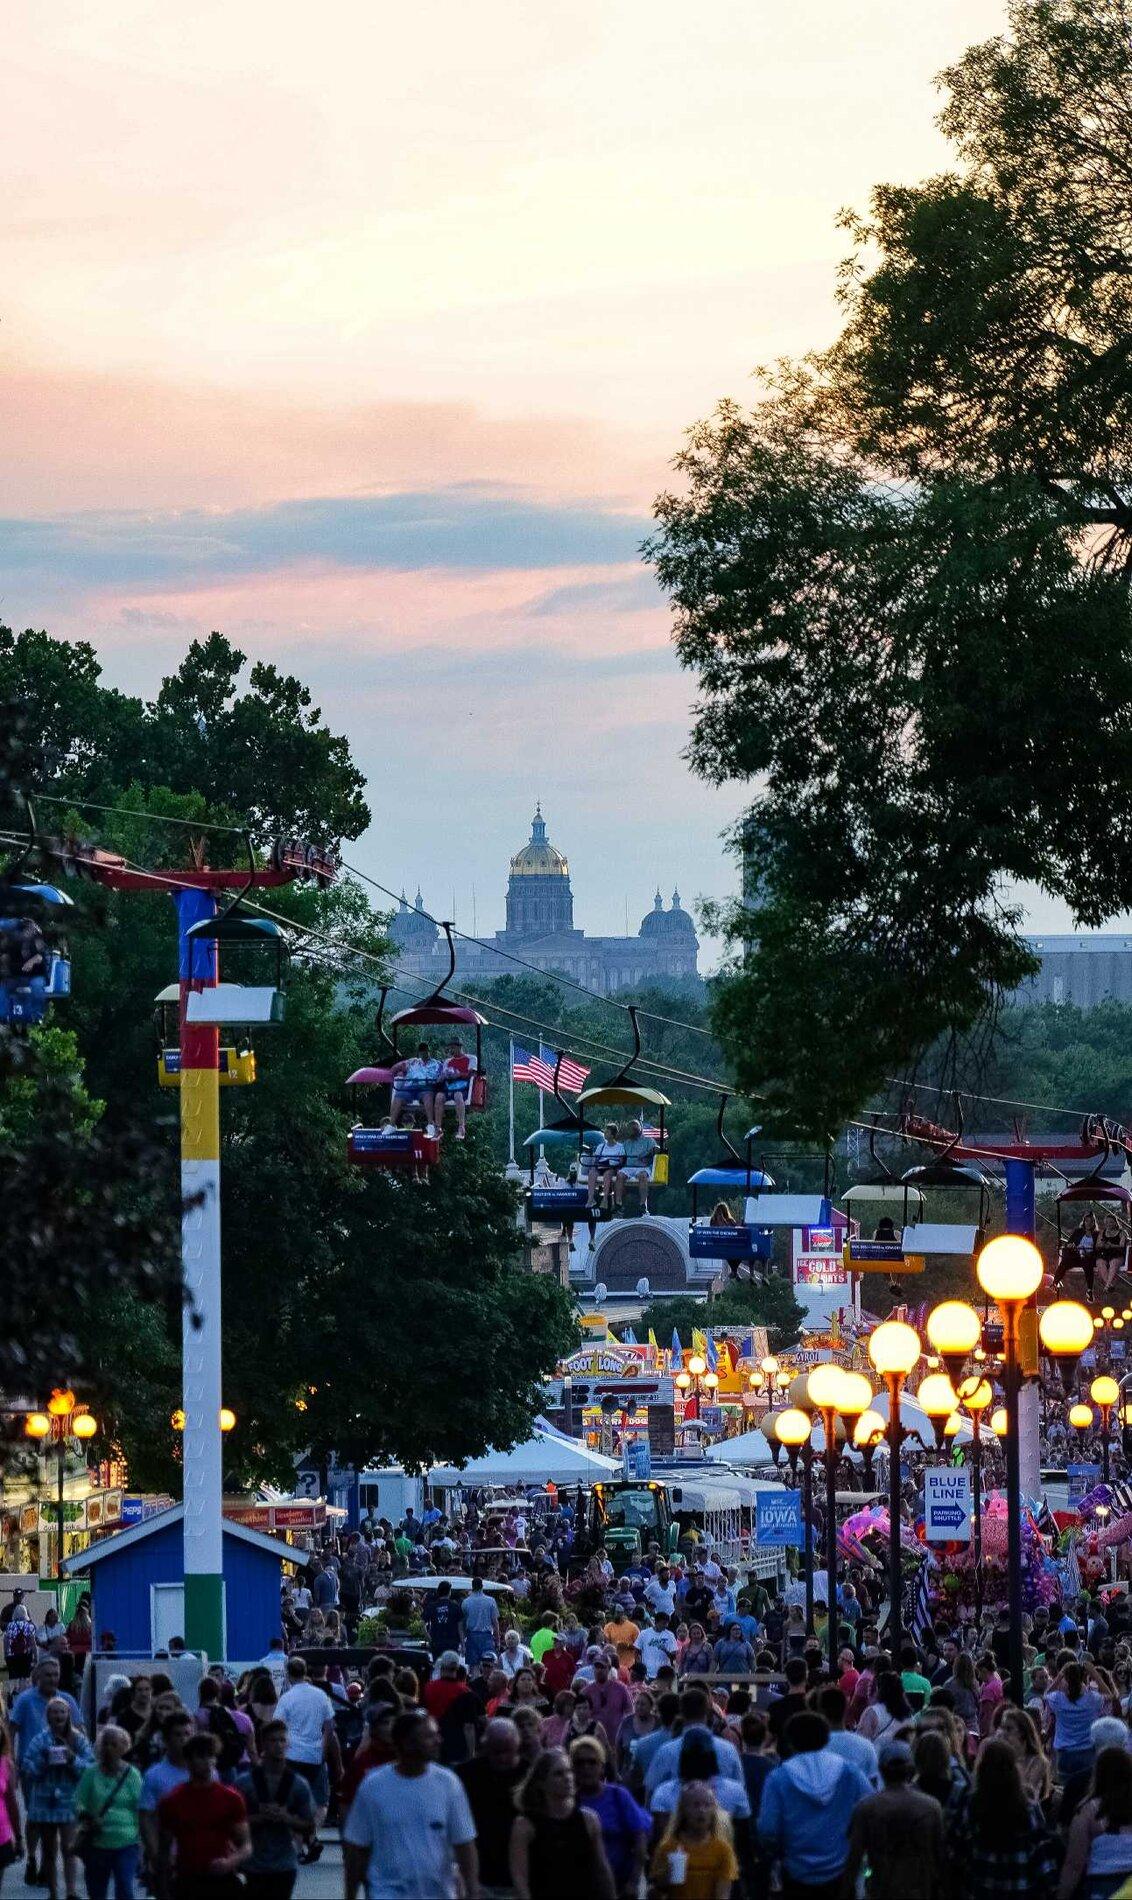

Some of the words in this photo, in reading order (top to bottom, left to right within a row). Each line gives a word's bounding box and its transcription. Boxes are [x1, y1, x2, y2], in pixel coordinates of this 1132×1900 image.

[13, 1004, 22, 1015] 13
[414, 1150, 422, 1159] 11
[591, 1208, 600, 1217] 10
[568, 1357, 593, 1372] FOOT
[597, 1355, 620, 1372] LONG
[930, 1478, 966, 1486] BLUE
[932, 1490, 964, 1498] LINE
[760, 1511, 797, 1523] IOWA
